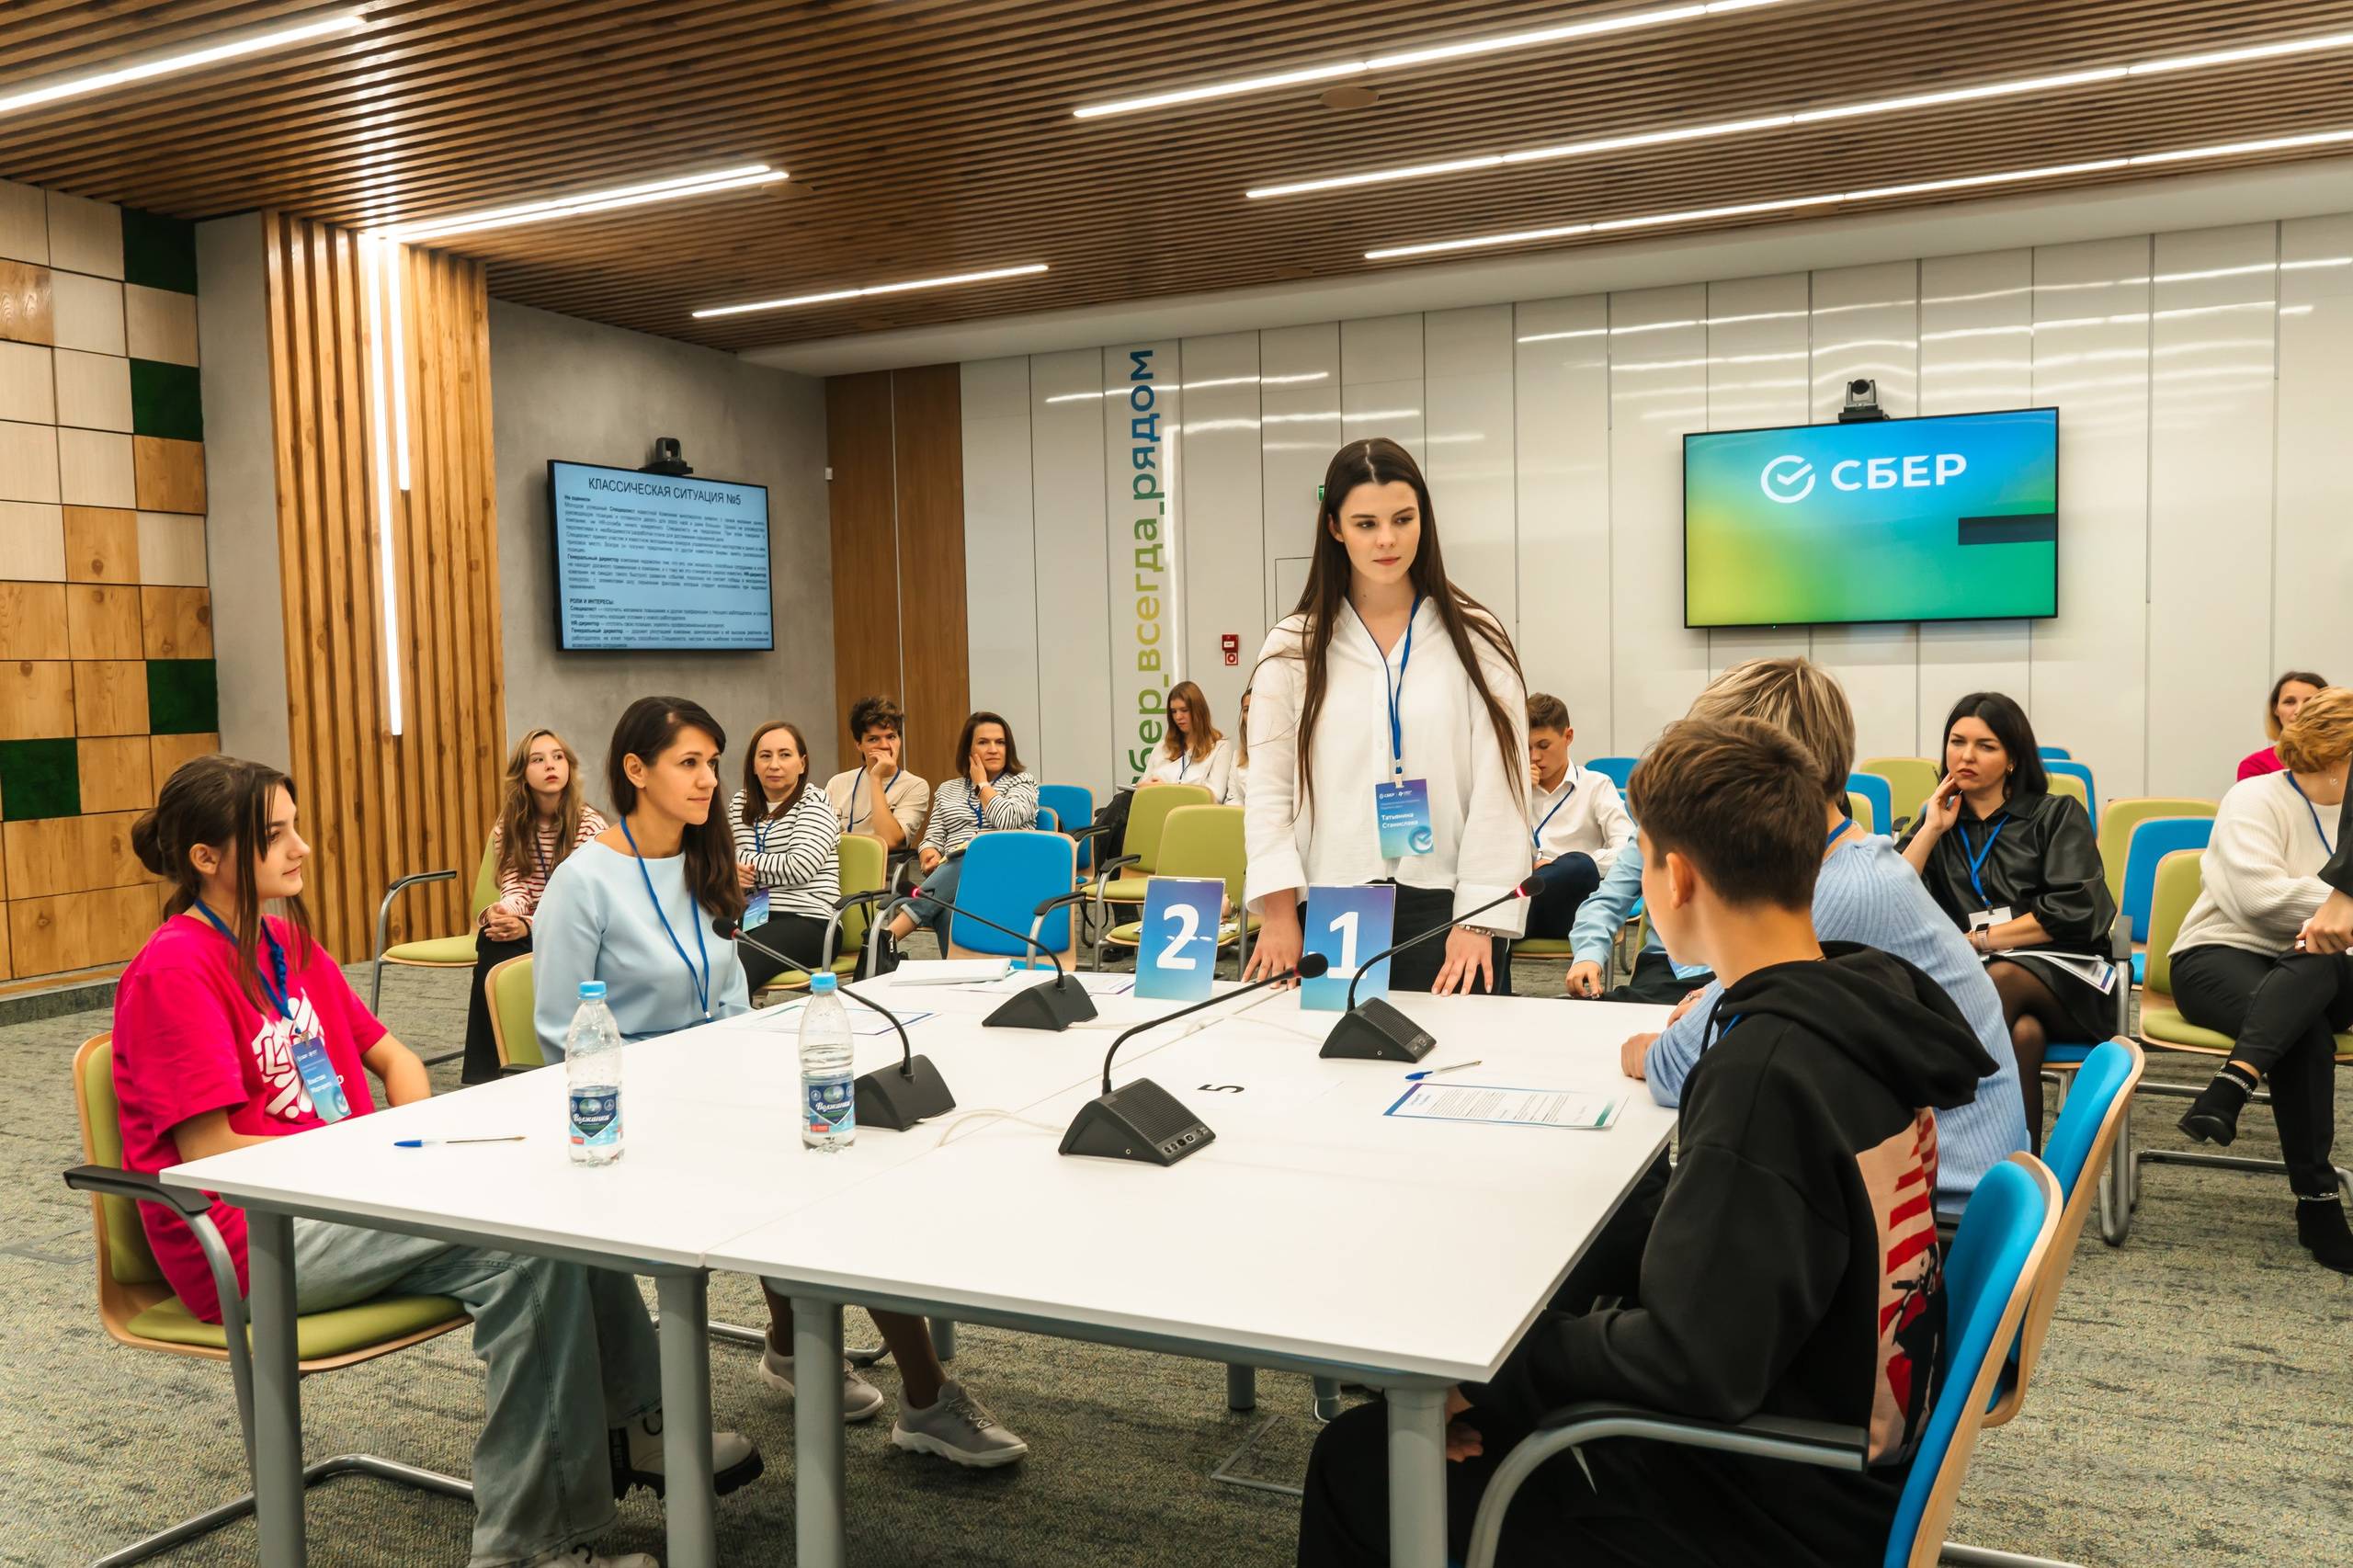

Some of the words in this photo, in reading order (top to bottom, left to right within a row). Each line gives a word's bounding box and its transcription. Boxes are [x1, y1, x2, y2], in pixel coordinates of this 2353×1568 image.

[588, 477, 671, 497] КЛАССИЧЕСКАЯ
[673, 486, 724, 505] СИТУАЦИЯ
[726, 493, 742, 506] №5
[1831, 453, 1967, 492] СБЕР
[1156, 903, 1199, 970] 2
[1327, 911, 1368, 979] 1
[1197, 1084, 1245, 1094] 5
